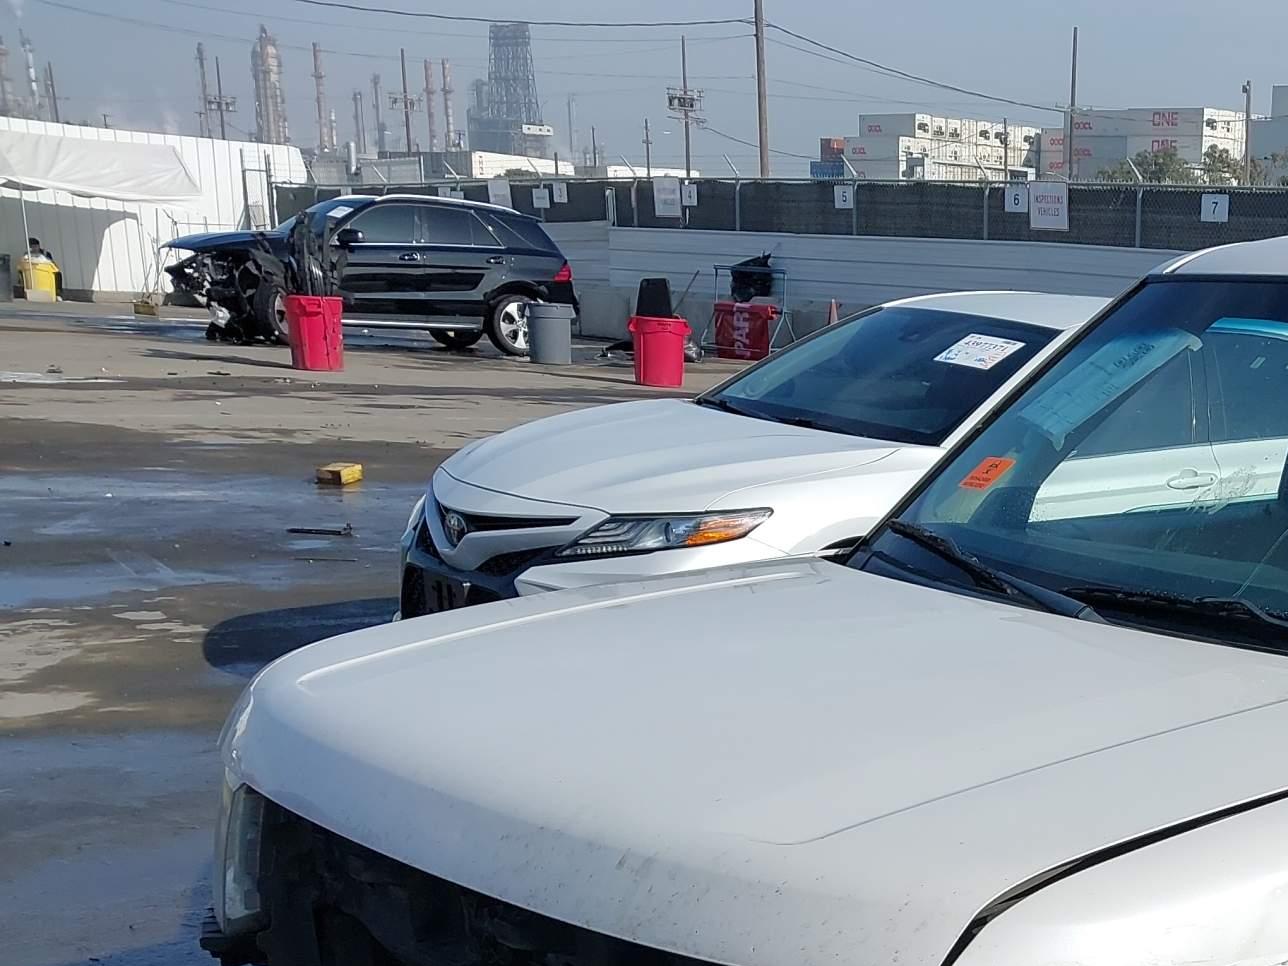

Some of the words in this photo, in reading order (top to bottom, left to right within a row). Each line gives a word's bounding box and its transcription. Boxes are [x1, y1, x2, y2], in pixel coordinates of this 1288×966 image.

[1152, 111, 1179, 127] ONE
[841, 191, 848, 203] 5
[1013, 193, 1020, 206] 6
[1210, 201, 1219, 217] 7
